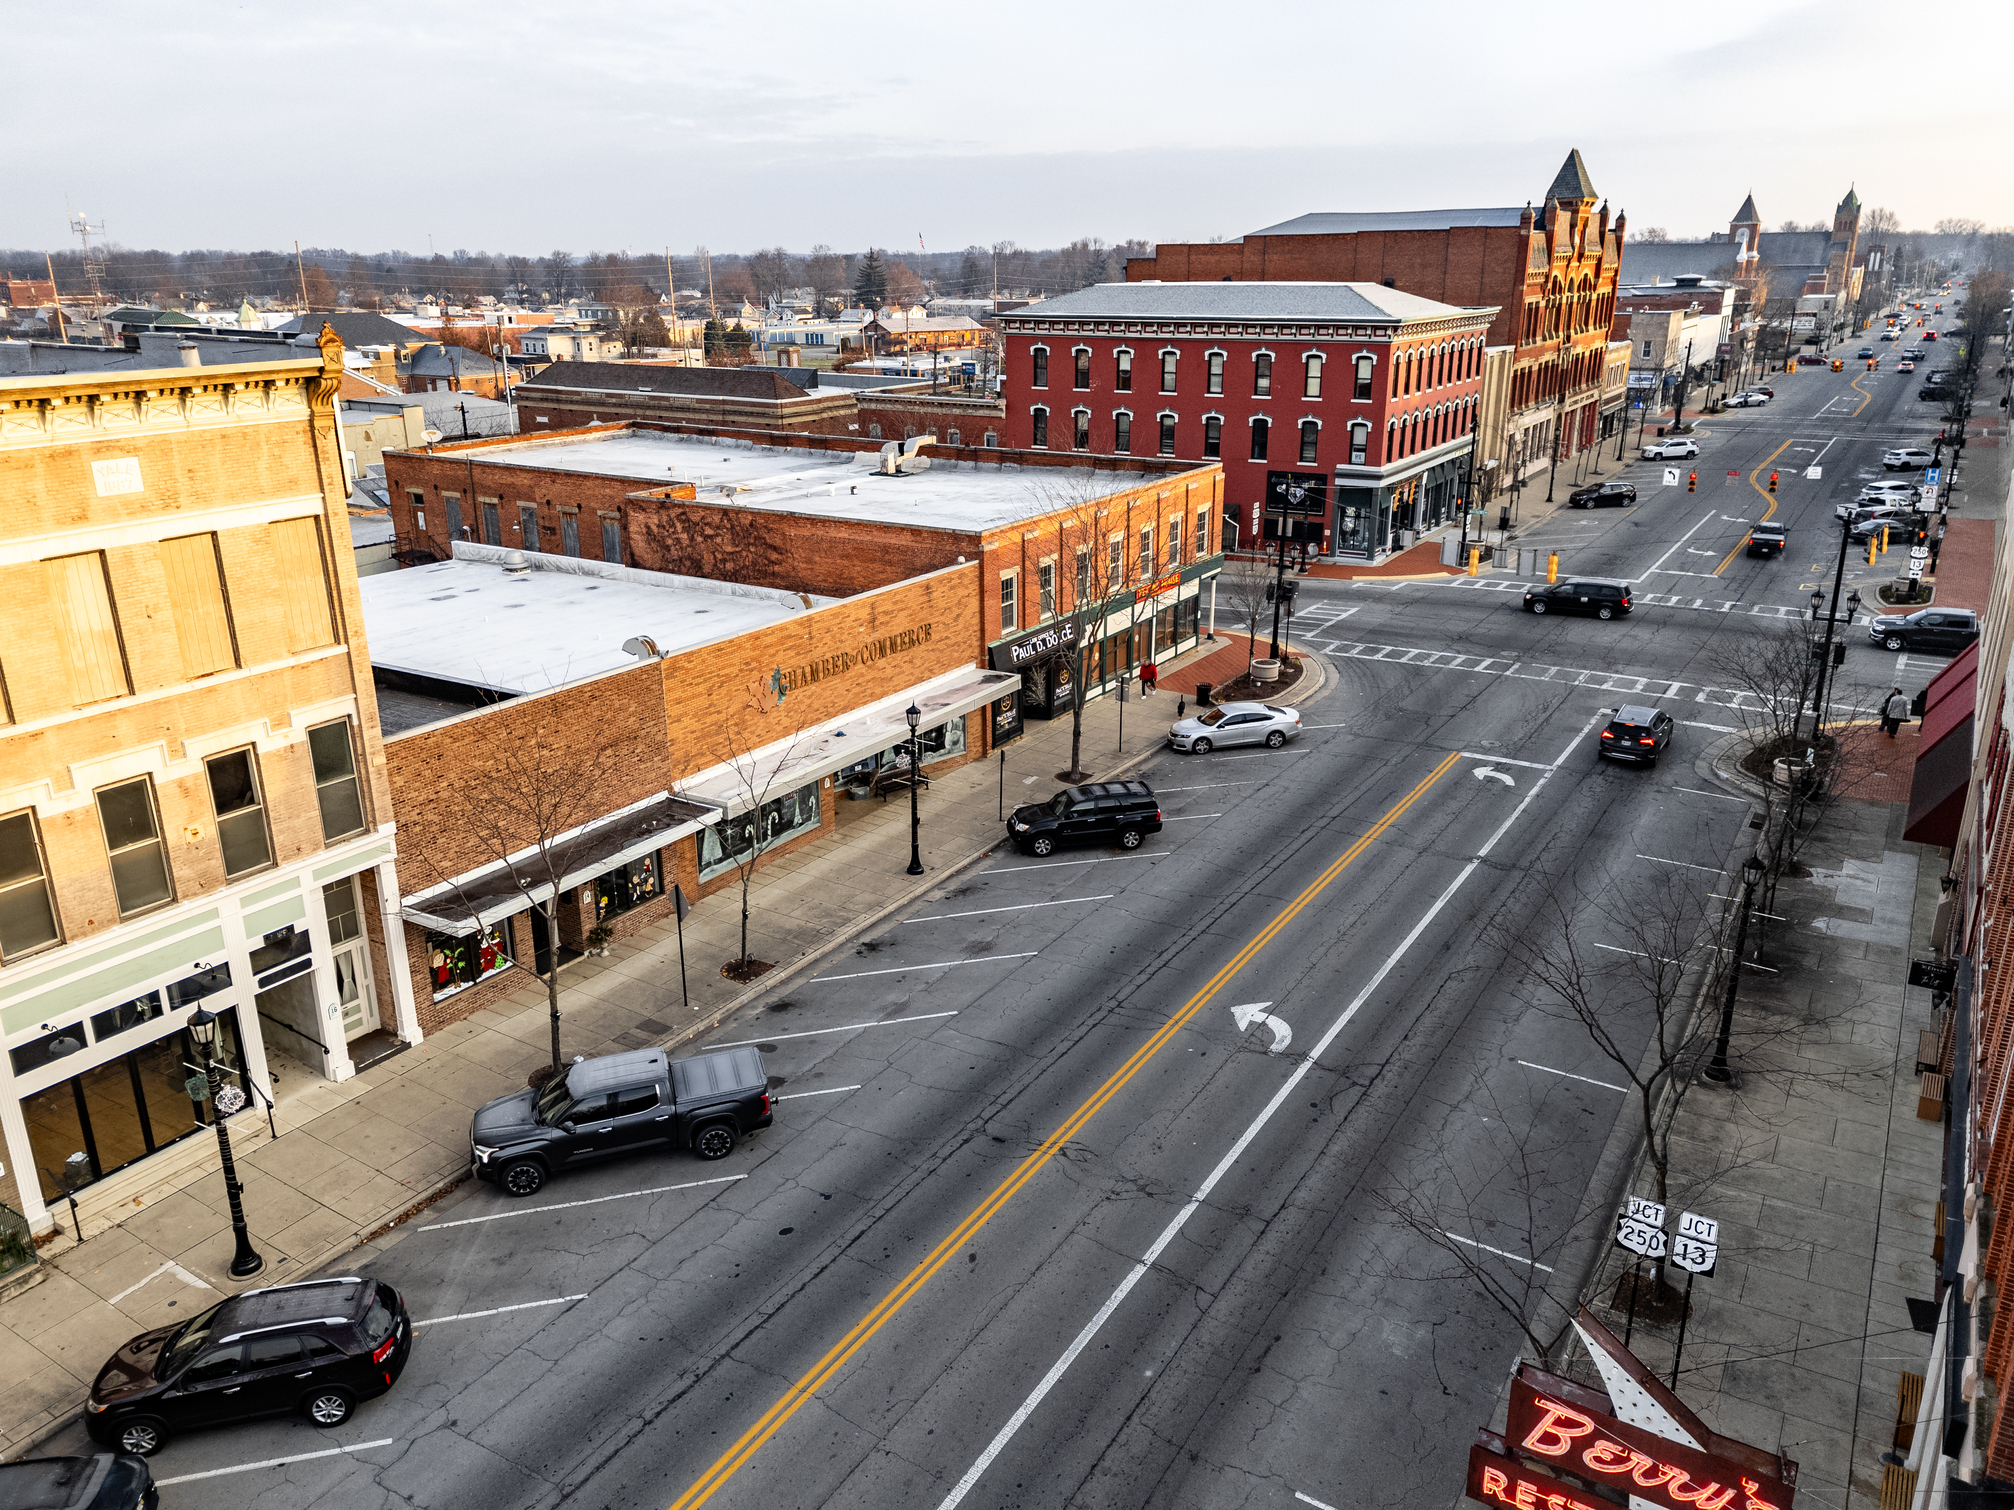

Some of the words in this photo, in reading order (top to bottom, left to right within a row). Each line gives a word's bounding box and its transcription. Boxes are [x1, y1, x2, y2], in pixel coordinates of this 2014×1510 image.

[96, 462, 135, 477] YALE
[1011, 645, 1036, 662] PAUL
[1036, 641, 1046, 652] D.
[1029, 636, 1038, 644] LAW
[1038, 632, 1049, 640] OFFICE
[779, 652, 850, 695] CHAMBER
[849, 650, 861, 665] of
[860, 623, 932, 664] COMMERCE
[1631, 1202, 1662, 1221] JCT
[1683, 1218, 1715, 1237] JCT
[1623, 1225, 1660, 1251] 250
[1682, 1243, 1707, 1266] 13
